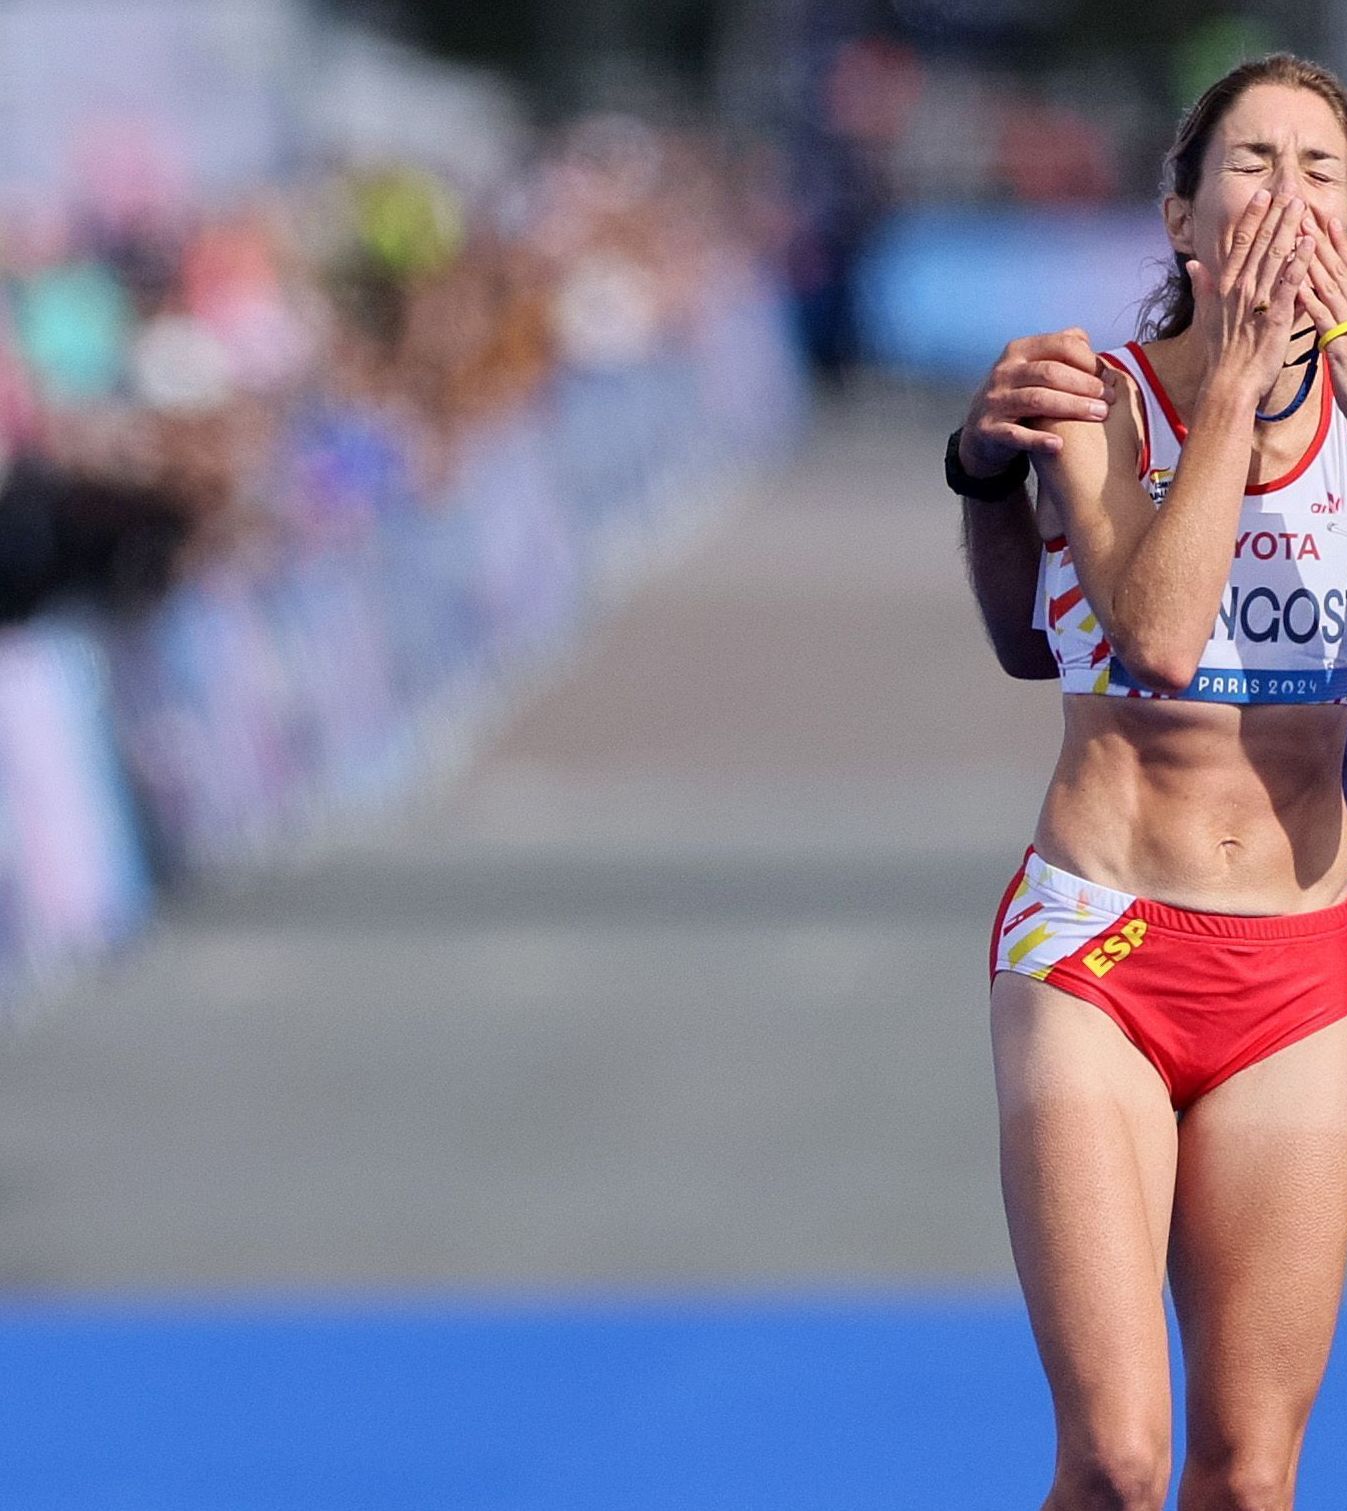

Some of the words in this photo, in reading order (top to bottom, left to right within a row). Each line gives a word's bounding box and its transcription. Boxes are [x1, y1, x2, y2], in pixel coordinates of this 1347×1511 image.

[1234, 531, 1321, 560] YOTA
[1198, 676, 1260, 695] PARIS
[1268, 679, 1317, 695] 2024
[1081, 918, 1149, 979] ESP
